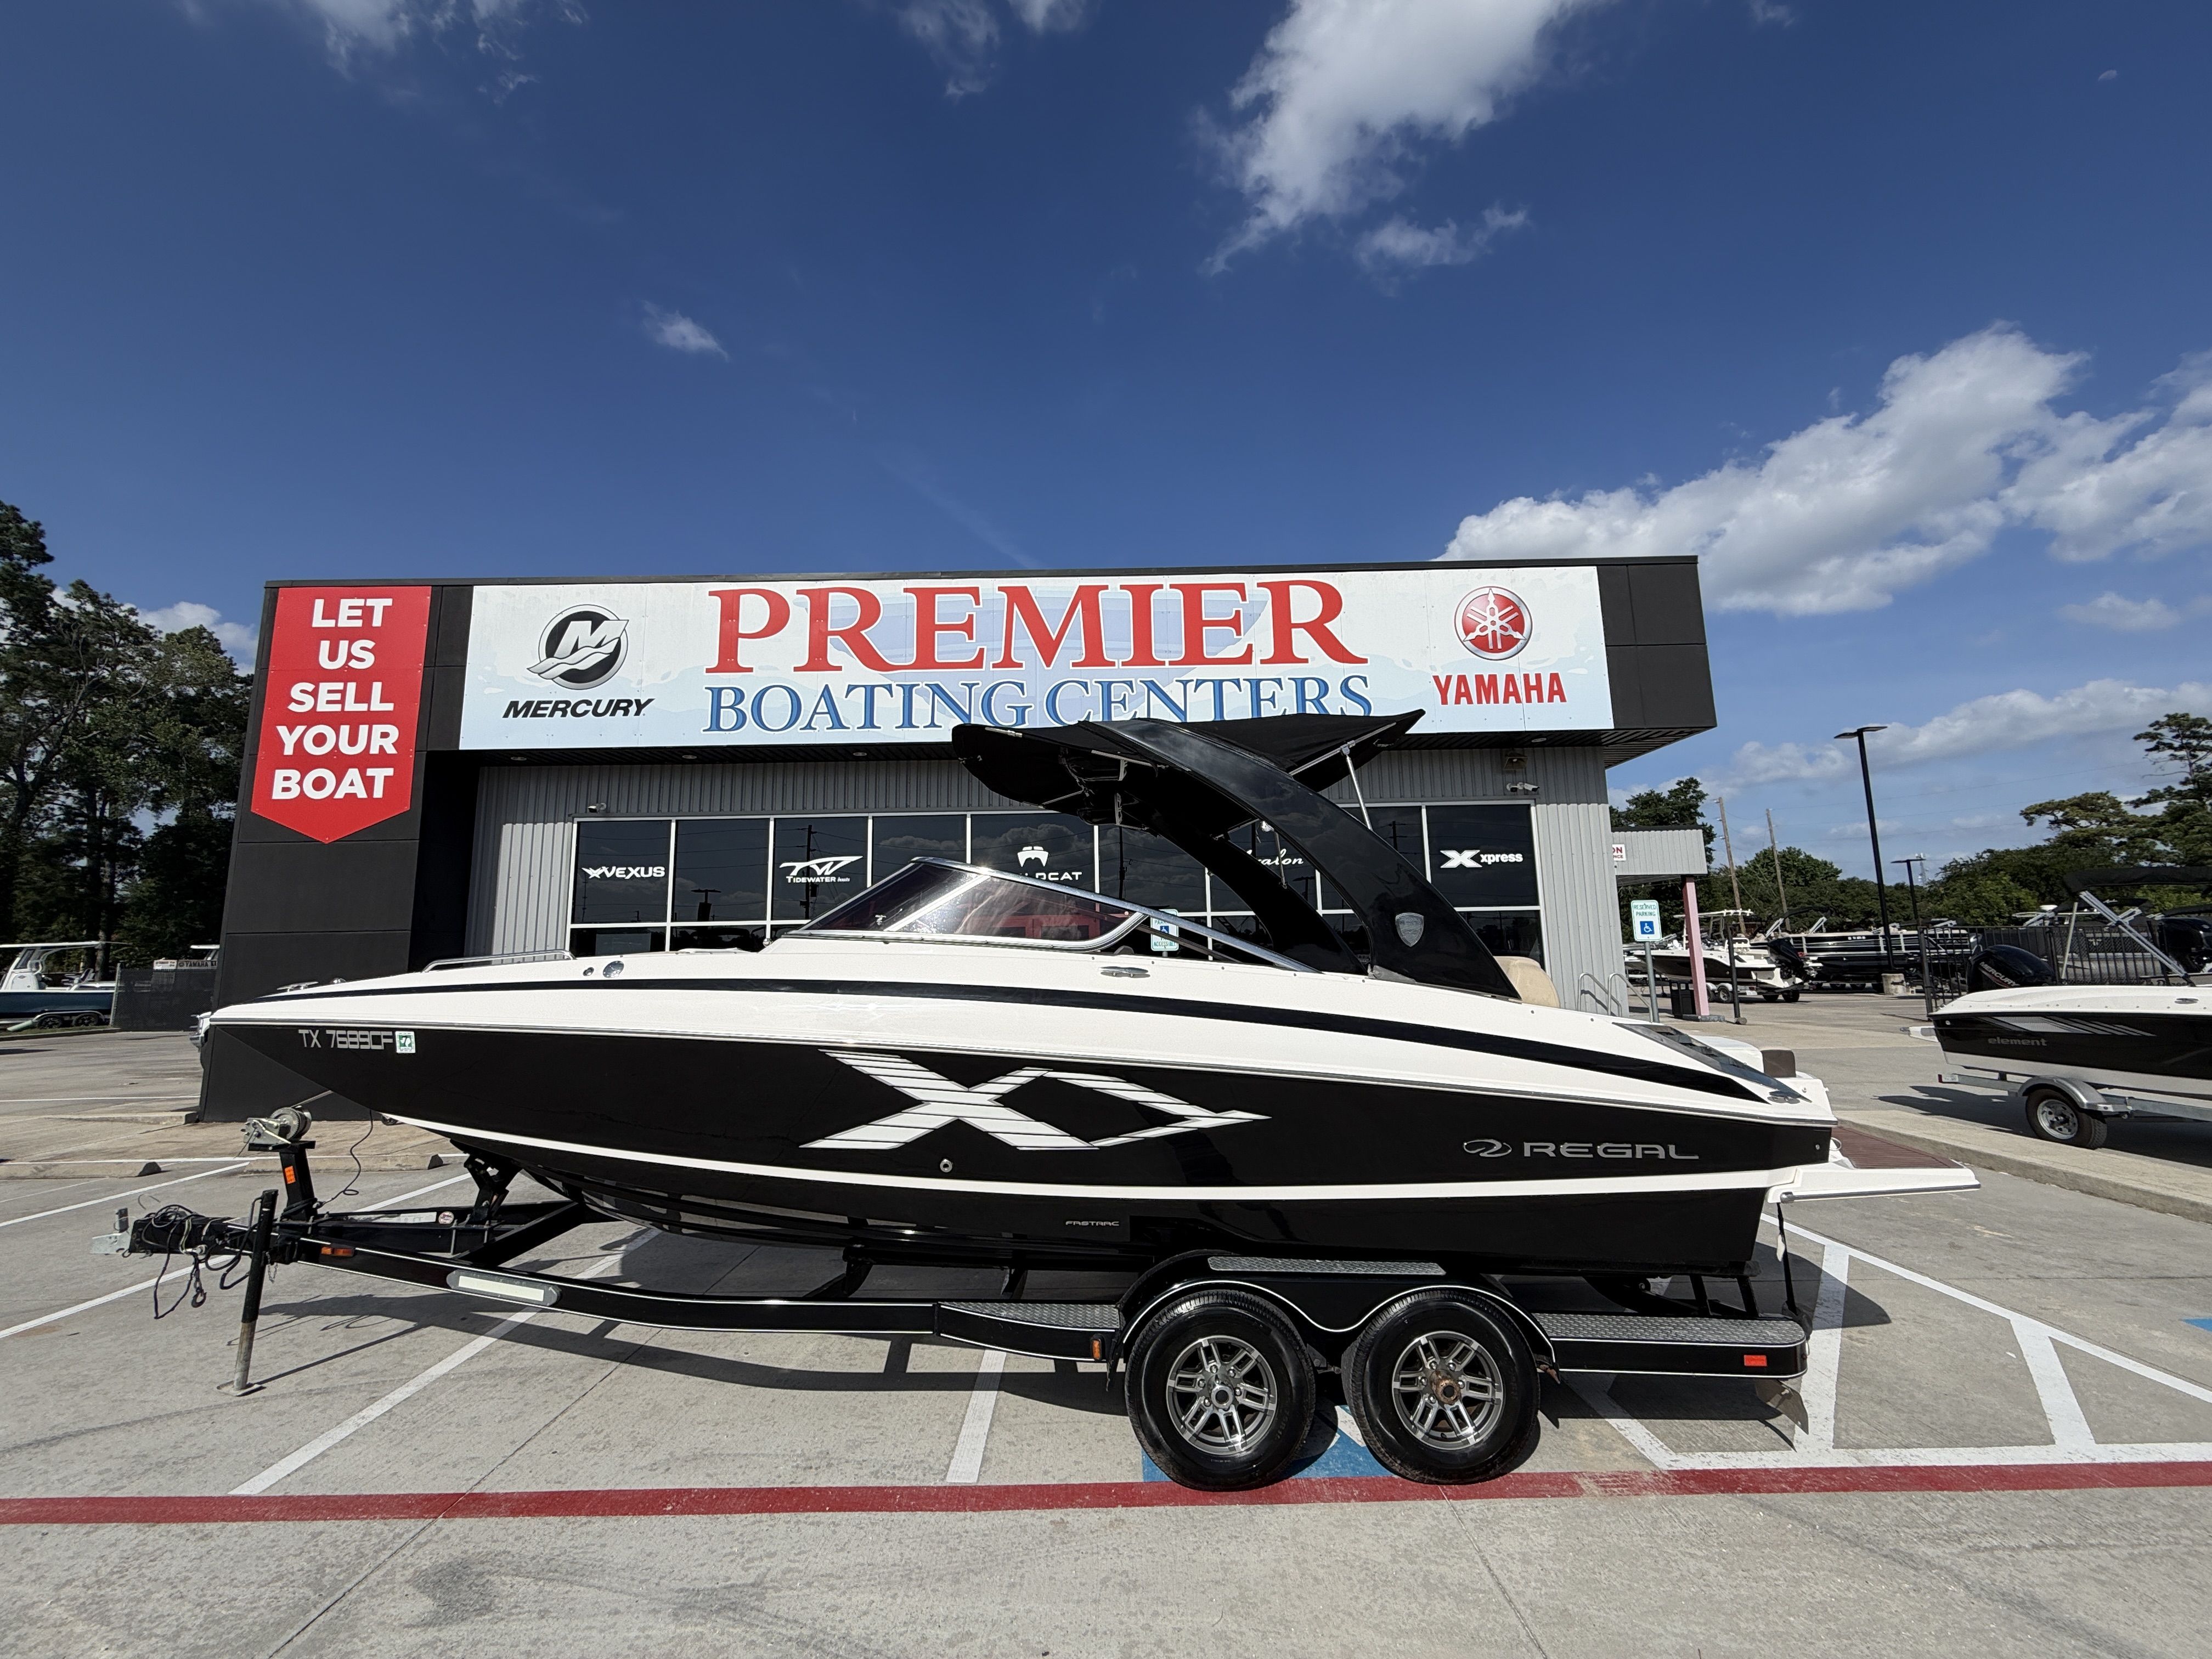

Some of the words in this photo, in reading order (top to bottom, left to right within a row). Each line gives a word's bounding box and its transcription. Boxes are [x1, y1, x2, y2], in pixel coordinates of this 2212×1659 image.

[312, 598, 393, 628] LET
[704, 579, 1368, 674] PREMIER
[319, 640, 375, 669] US
[287, 682, 394, 713] SELL
[703, 681, 1034, 732] BOATING
[1045, 675, 1373, 725] CENTERS
[1433, 673, 1567, 705] YAMAHA
[502, 698, 656, 718] MERCURY
[276, 724, 399, 755] YOUR
[272, 768, 394, 799] BOAT
[602, 866, 665, 879] VEXUS
[1480, 853, 1523, 865] xpress
[1979, 962, 2020, 986] MERCURY
[298, 1029, 321, 1048] TX
[326, 1030, 393, 1049] 7689CF
[1988, 1037, 2047, 1046] element
[1523, 1142, 1700, 1159] REGAL
